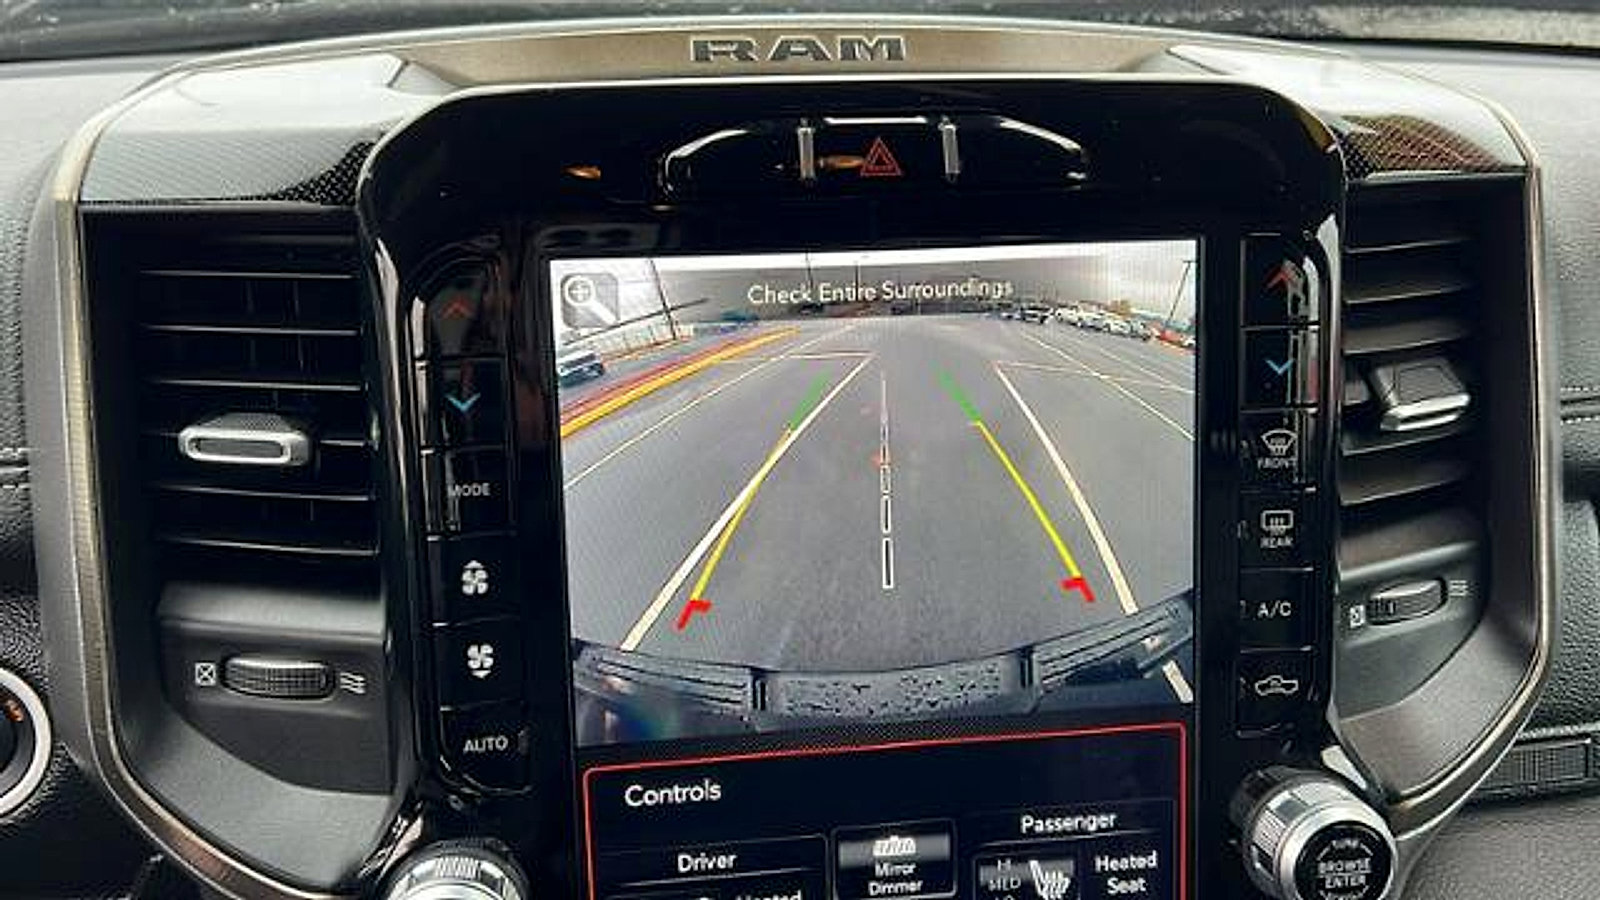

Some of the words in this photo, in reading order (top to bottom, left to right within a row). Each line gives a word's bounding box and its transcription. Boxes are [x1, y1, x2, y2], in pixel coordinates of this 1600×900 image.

[690, 35, 906, 61] RAM
[747, 281, 812, 304] Check
[819, 281, 877, 302] Entire
[882, 277, 1014, 301] Surroundings
[447, 482, 491, 497] MODE
[1257, 601, 1293, 618] A/C
[463, 735, 509, 754] AUTO
[624, 778, 722, 807] Controls
[1020, 812, 1118, 835] Passenger
[677, 852, 737, 873] Driver
[874, 861, 917, 877] Mirror
[1094, 850, 1158, 872] Heated
[868, 880, 923, 897] Dimmer
[1106, 876, 1148, 896] Seat
[1325, 874, 1367, 890] ENTER
